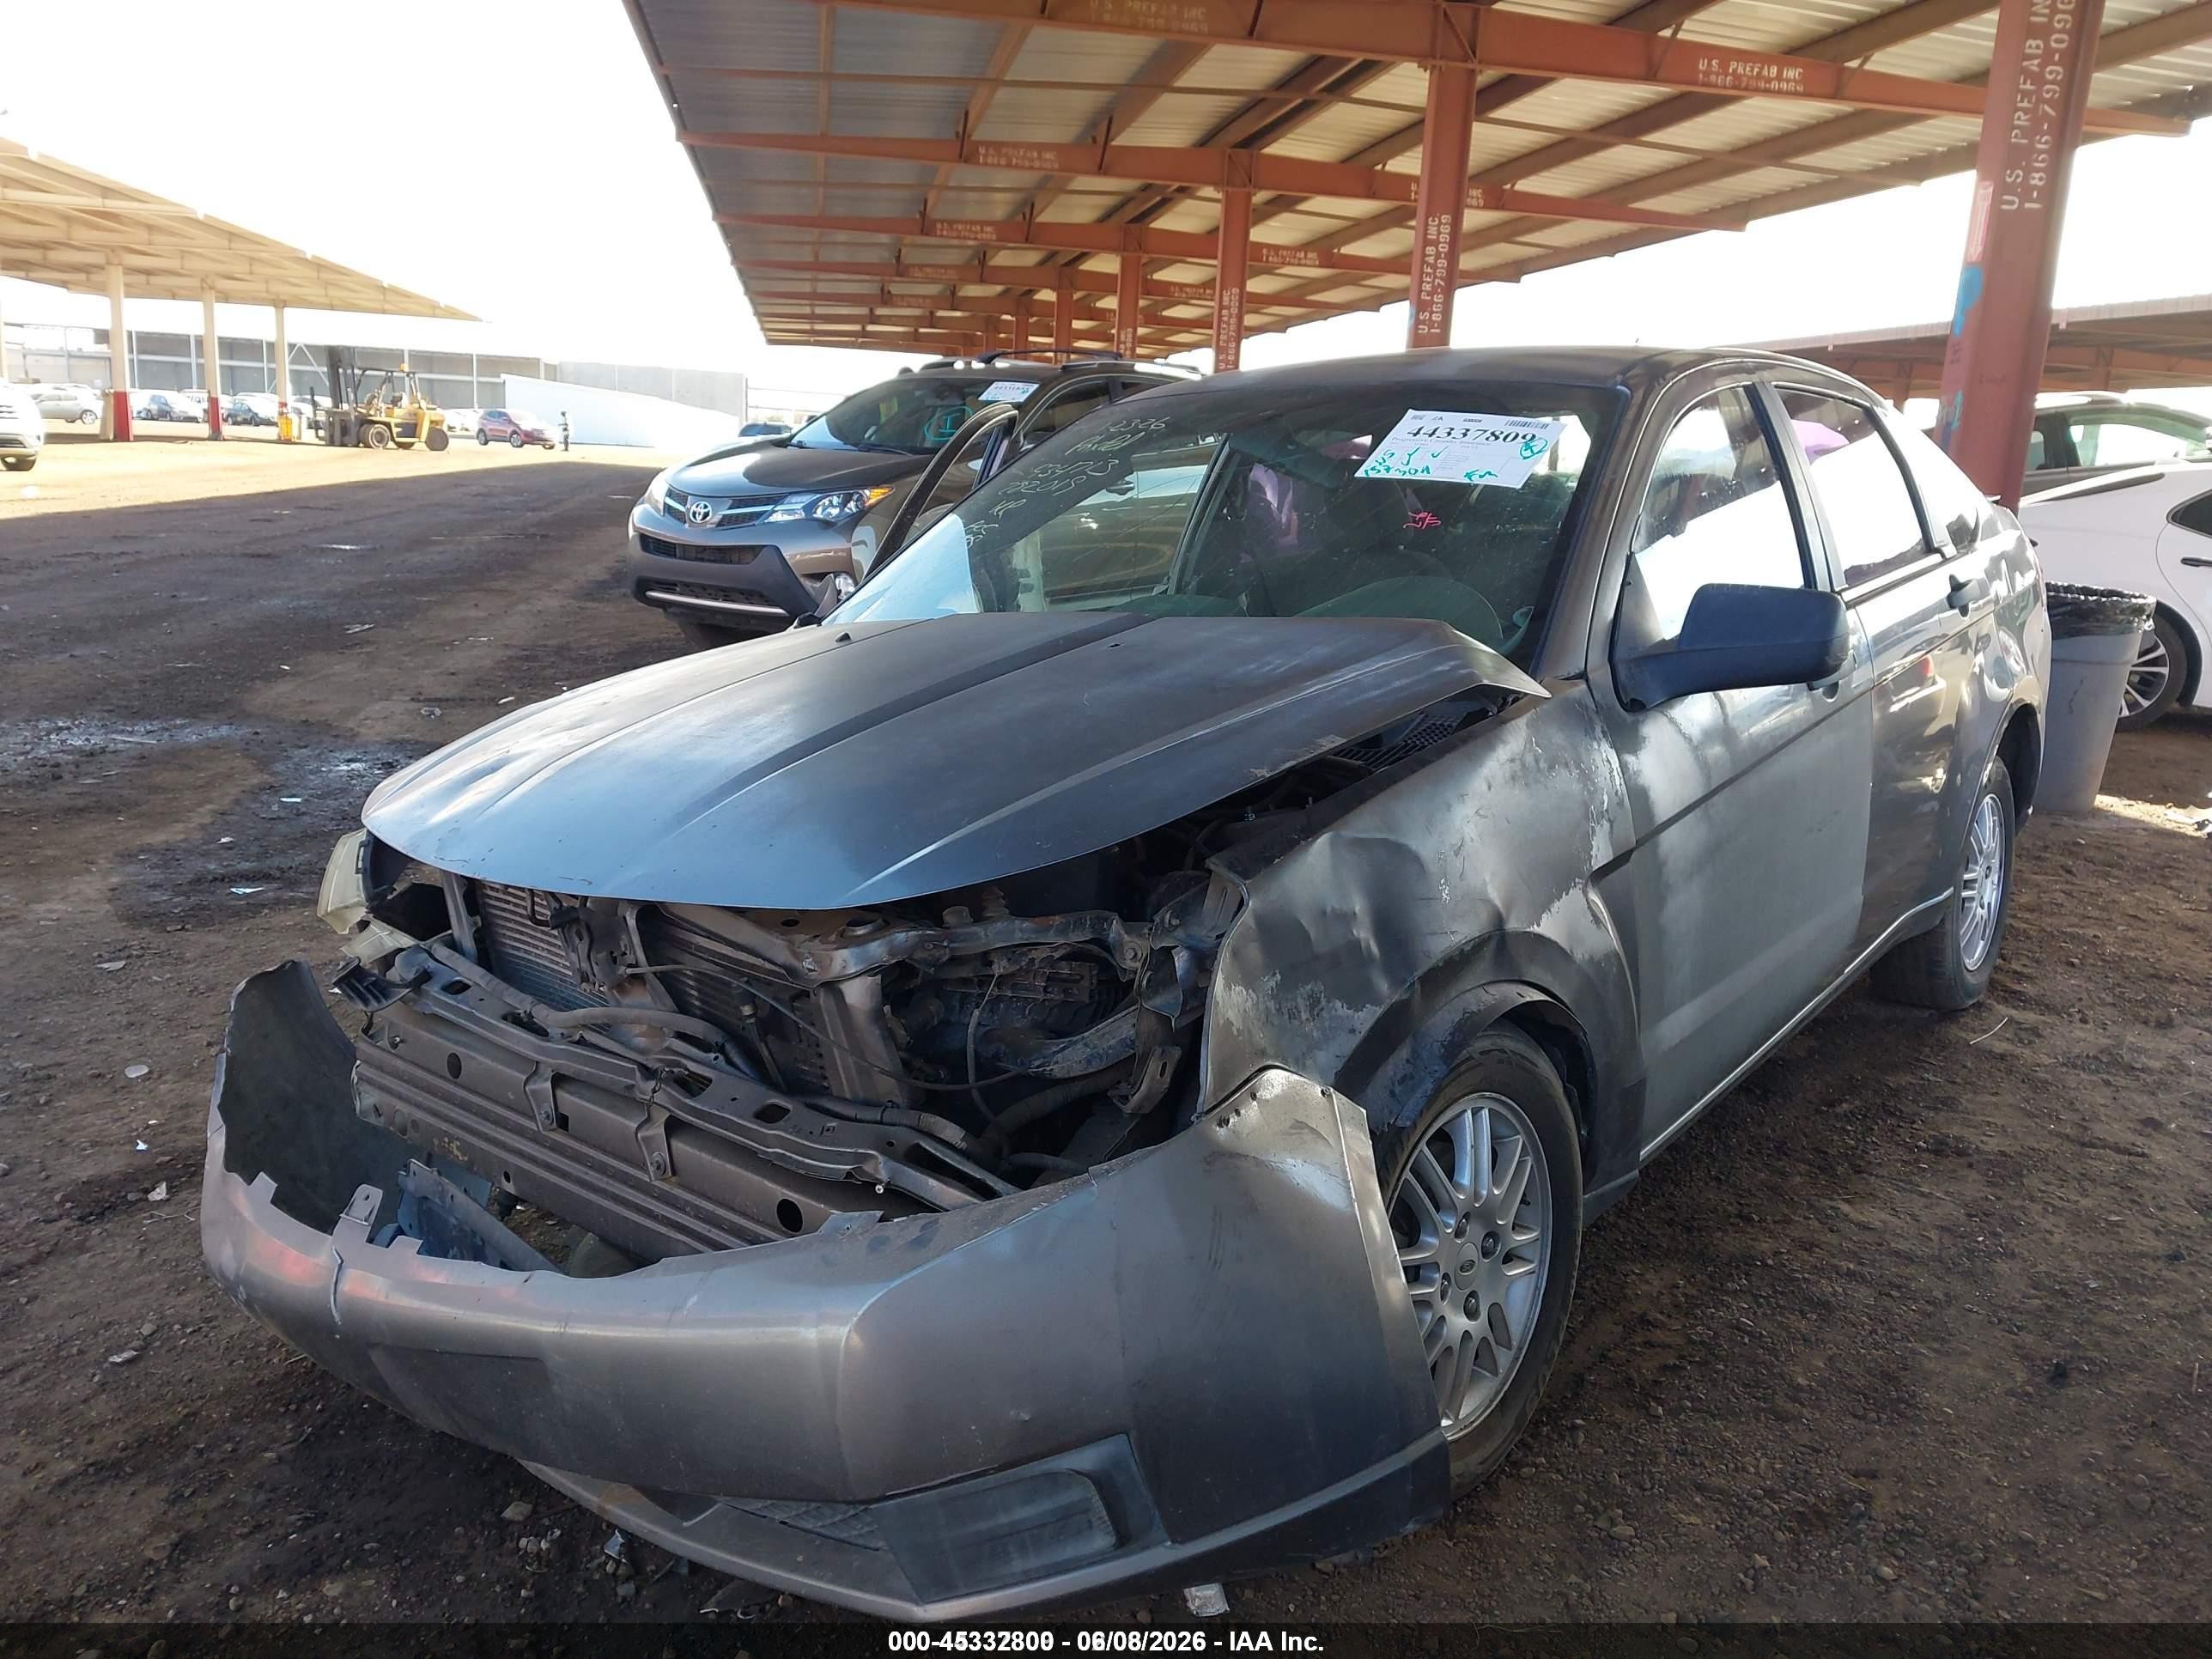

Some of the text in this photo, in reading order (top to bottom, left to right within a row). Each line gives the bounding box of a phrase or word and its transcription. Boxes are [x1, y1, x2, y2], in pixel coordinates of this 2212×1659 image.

[1698, 58, 1723, 73] U.S.
[1729, 61, 1778, 77] PREFAB
[2000, 0, 2051, 210] U.S. PREFAB IN
[1421, 246, 1437, 300] PREFAB
[1219, 309, 1230, 346] PREFAB
[1418, 307, 1431, 334] U.S.
[1406, 425, 1537, 444] 44337809
